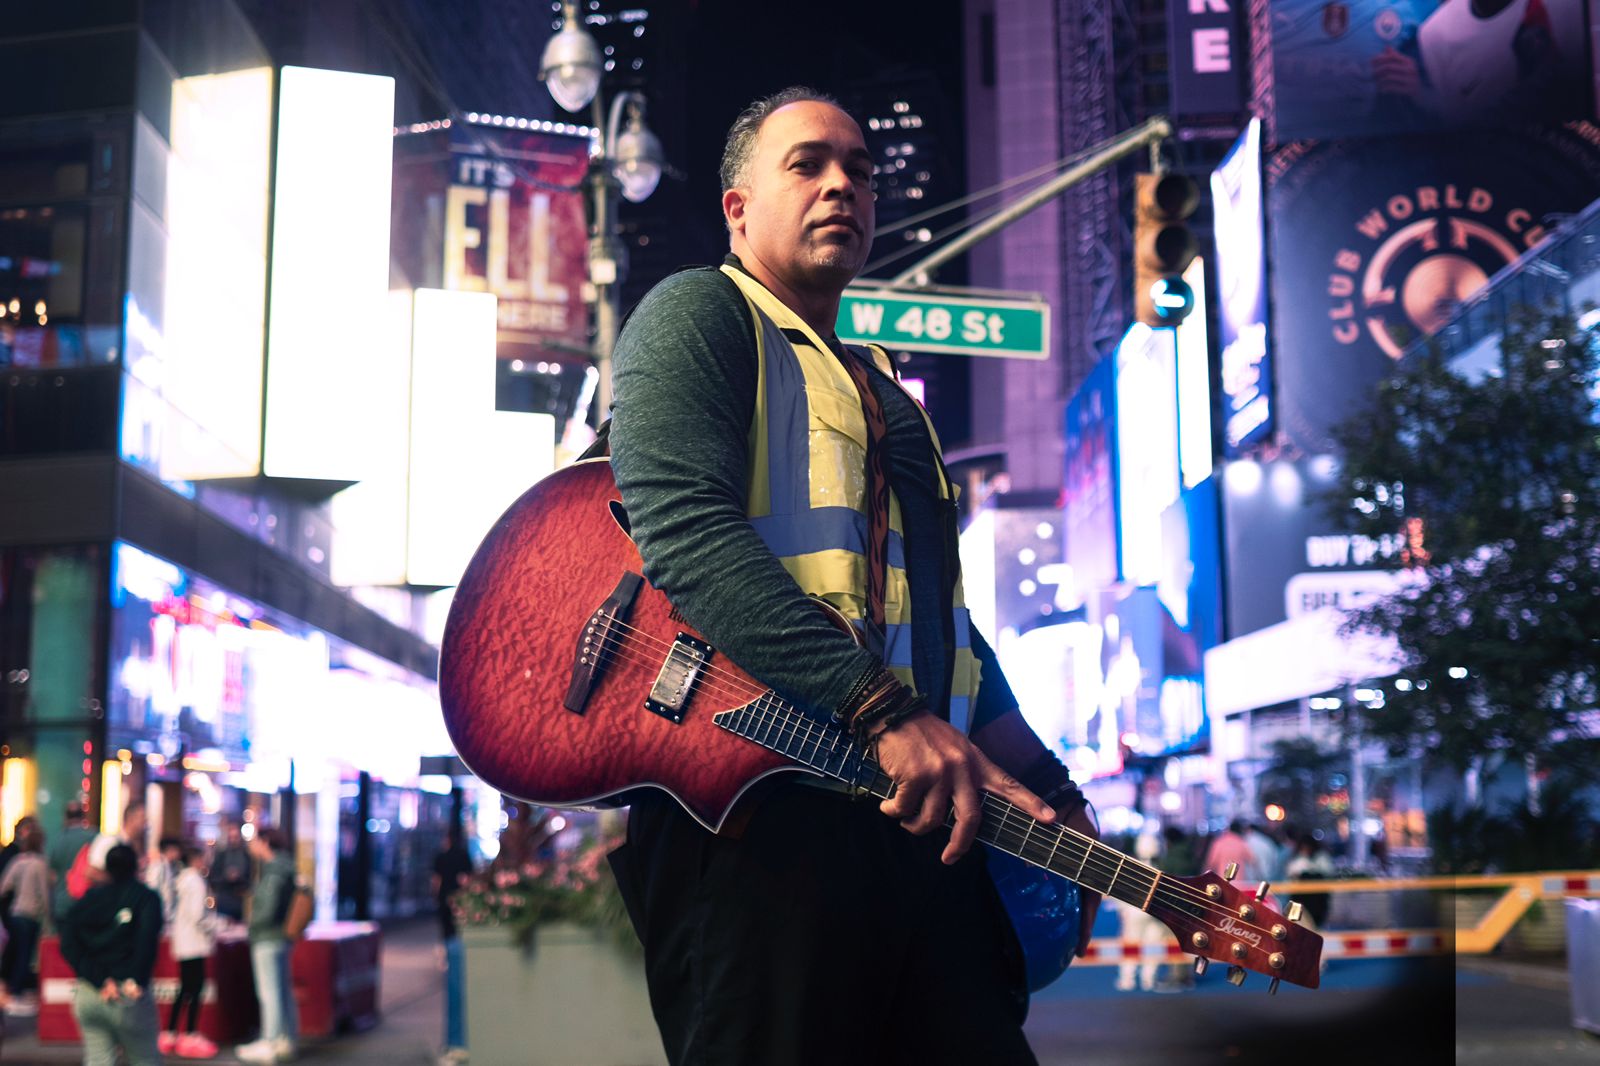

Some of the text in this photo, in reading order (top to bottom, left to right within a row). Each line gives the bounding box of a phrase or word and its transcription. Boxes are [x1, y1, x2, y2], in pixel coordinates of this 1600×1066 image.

[1328, 248, 1362, 345] CLUB
[1355, 184, 1493, 240] WORLD
[851, 302, 1005, 344] W 48 St
[1217, 917, 1262, 947] Ibanez
